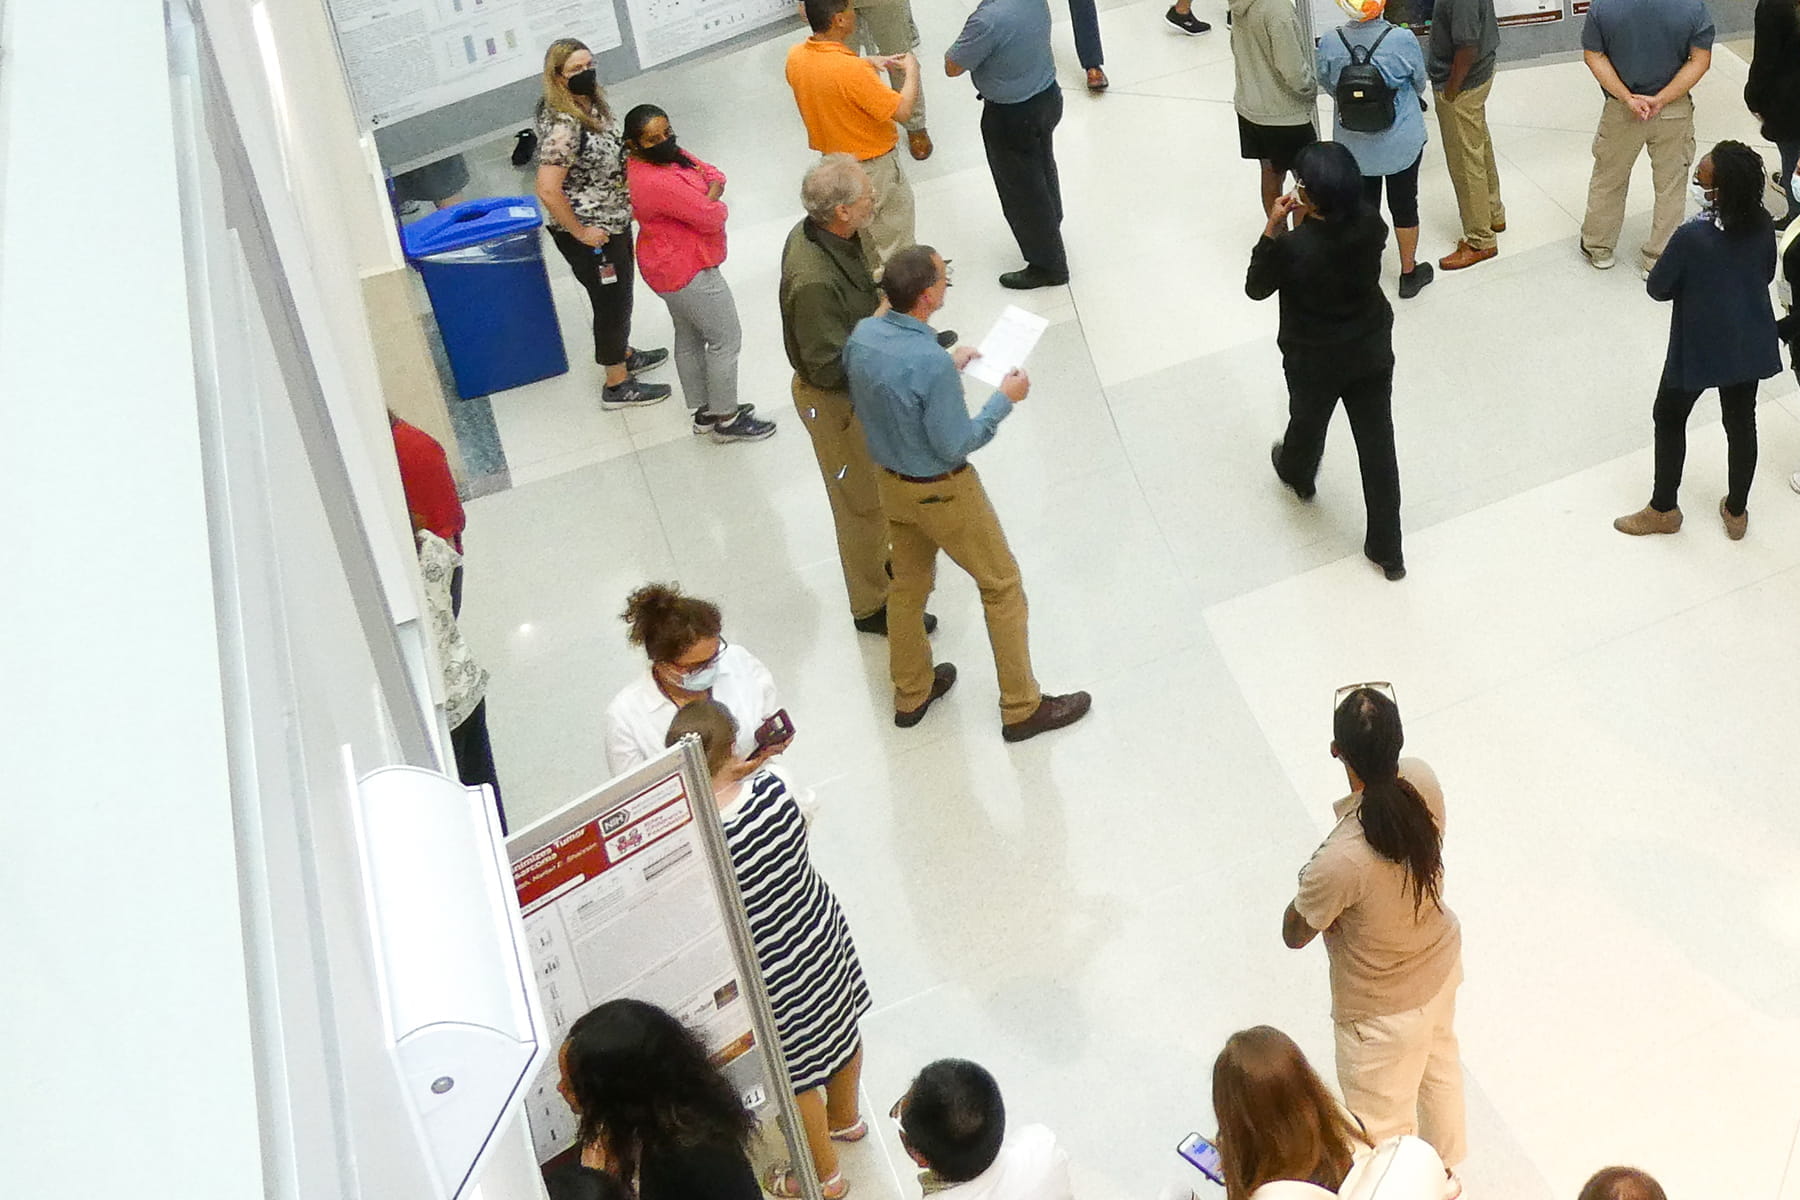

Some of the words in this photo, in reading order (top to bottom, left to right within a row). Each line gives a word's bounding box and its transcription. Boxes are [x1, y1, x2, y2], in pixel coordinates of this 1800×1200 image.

[603, 814, 625, 832] NIH
[513, 846, 553, 872] nimizes
[554, 828, 585, 849] Tumor
[514, 853, 558, 879] sarcoma
